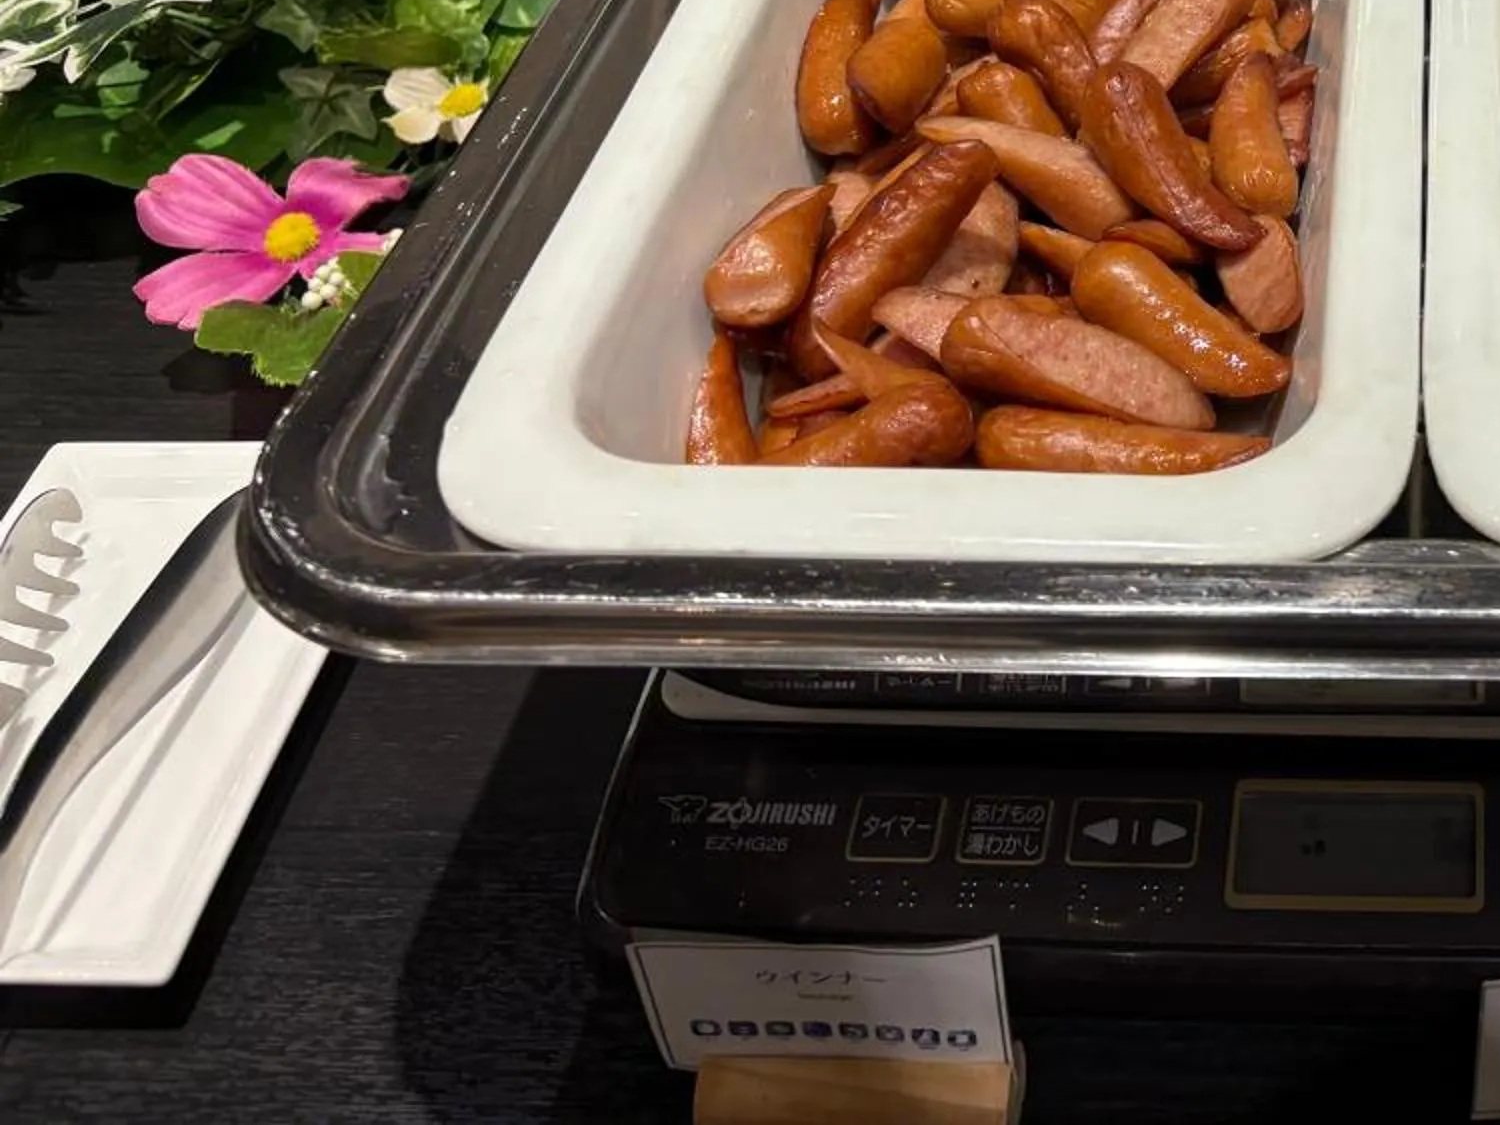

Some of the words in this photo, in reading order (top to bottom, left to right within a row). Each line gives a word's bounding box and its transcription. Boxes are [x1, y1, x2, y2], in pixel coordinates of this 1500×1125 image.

[706, 797, 838, 830] ZOJIRUSHI
[971, 803, 1045, 826] あげもの
[861, 815, 934, 841] タイマー
[704, 835, 791, 854] EZ-HG26
[965, 834, 1041, 857] 湯わかし
